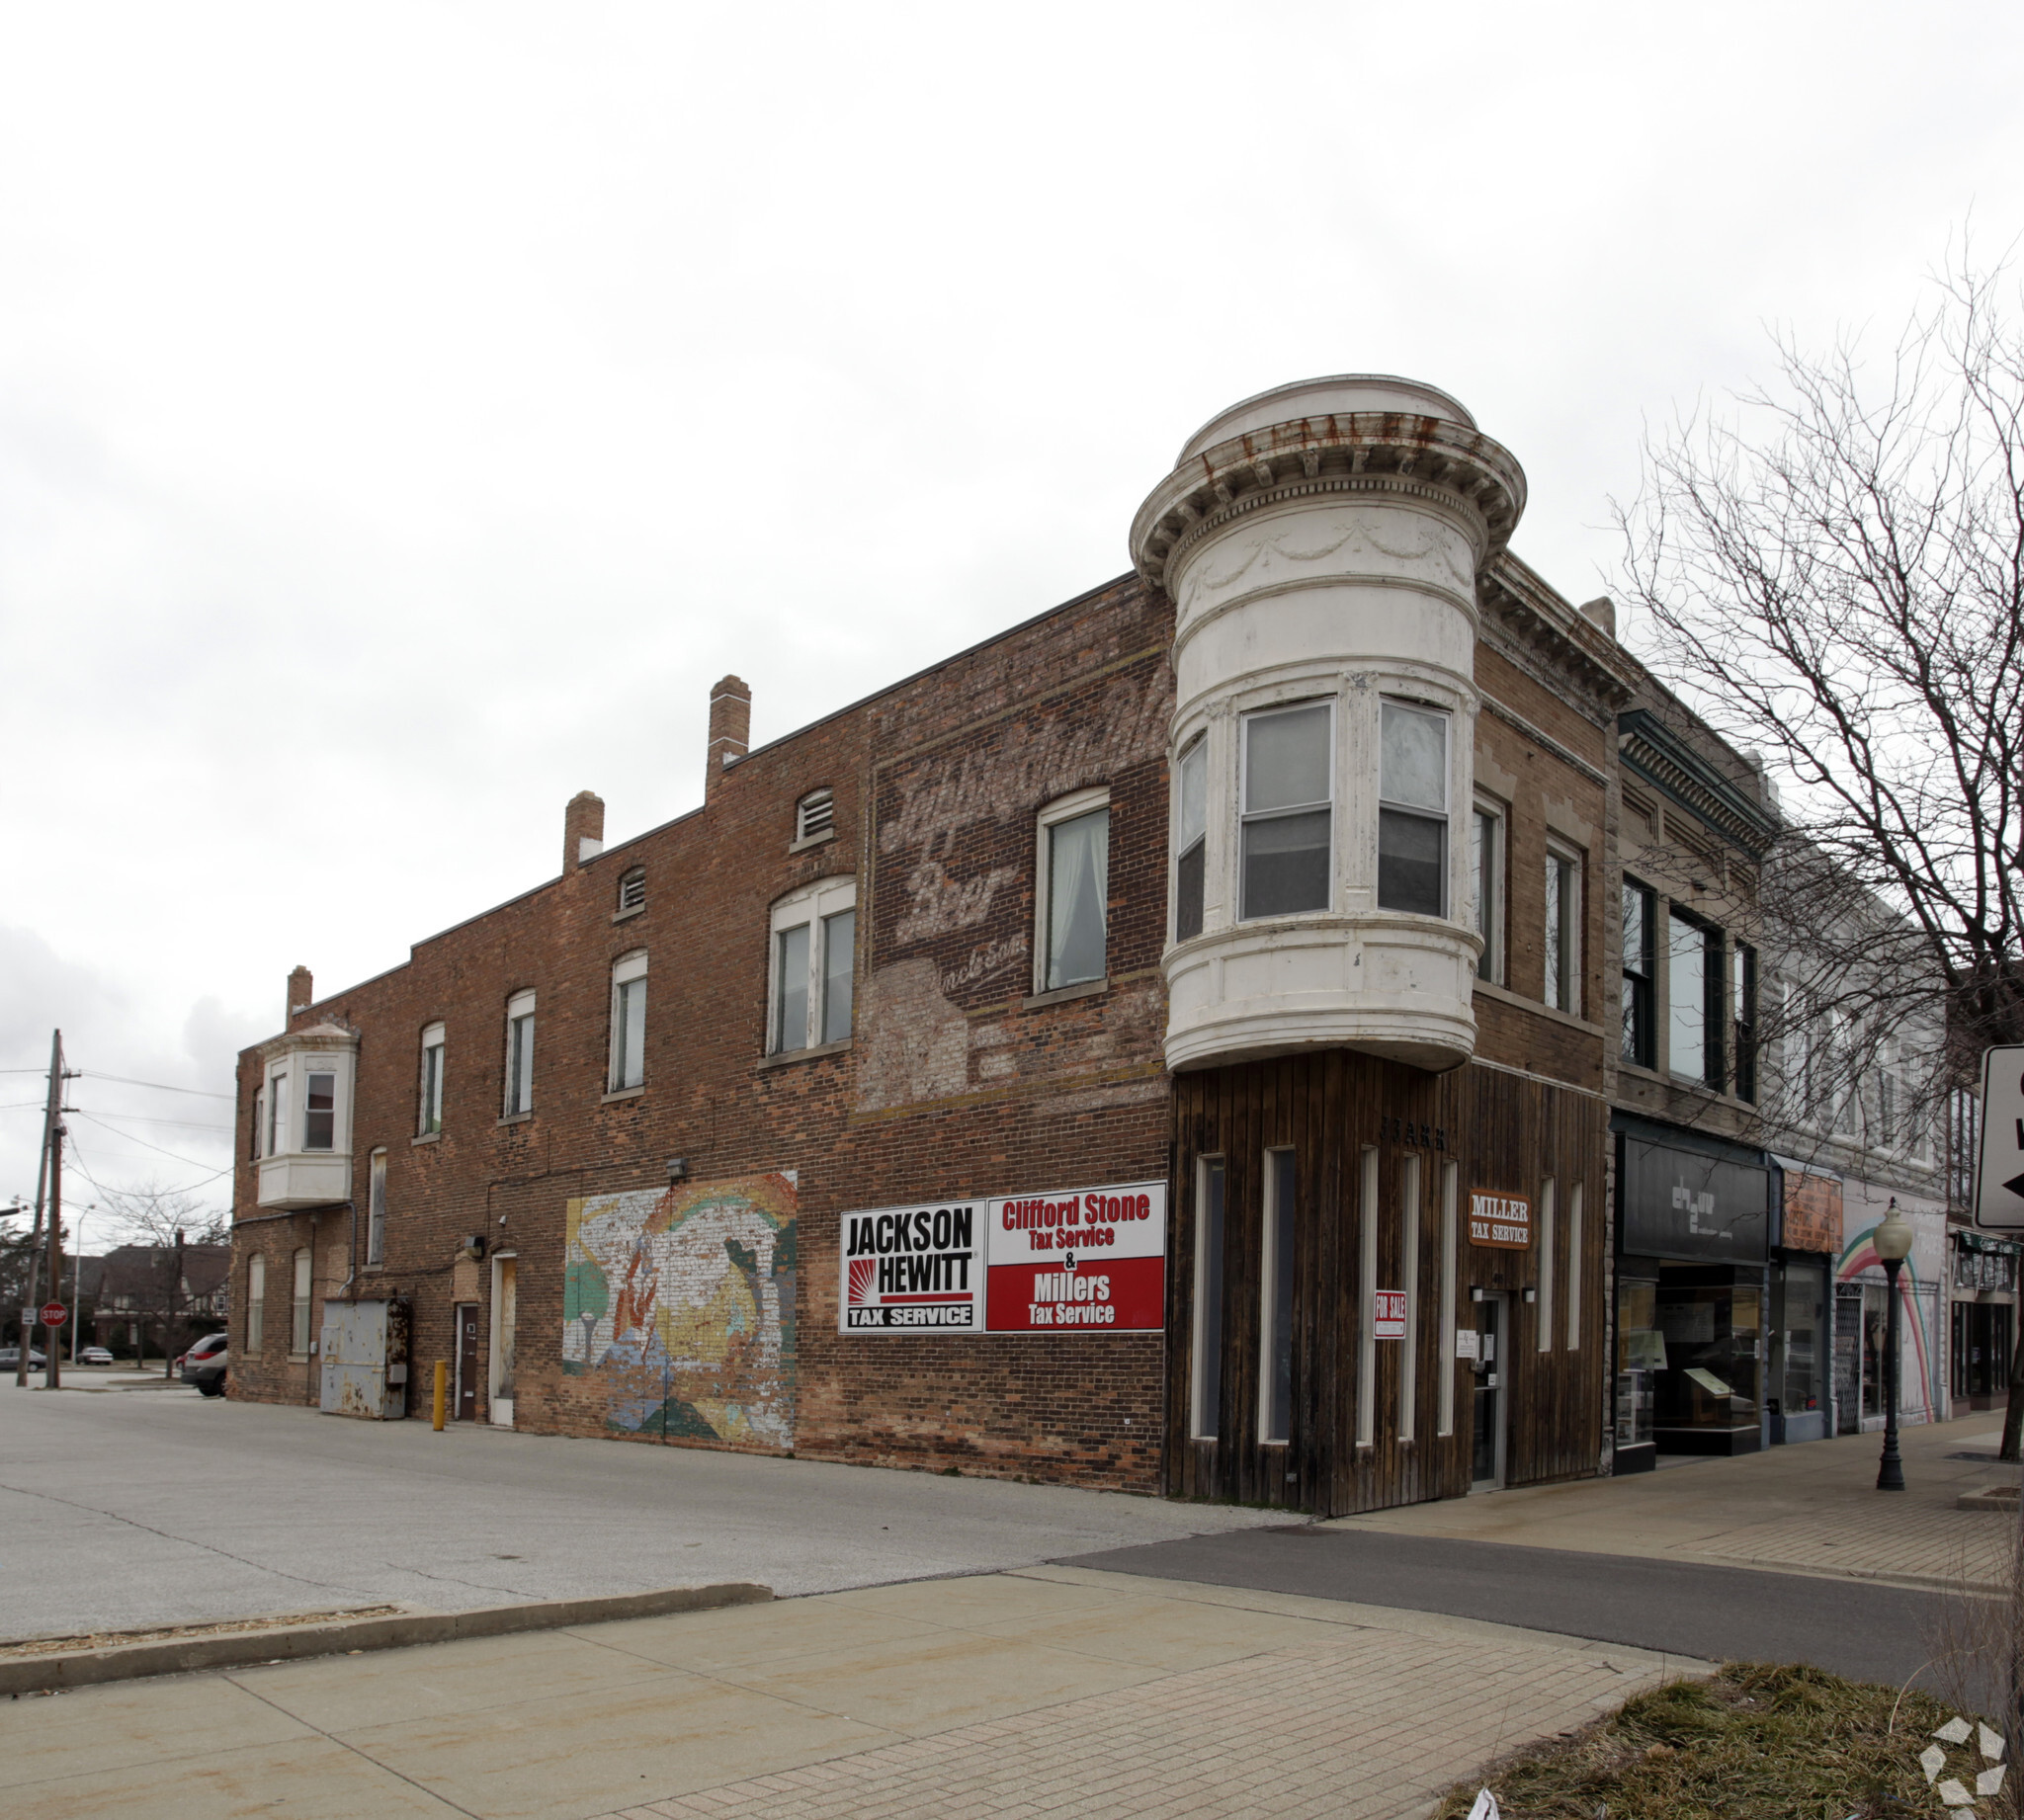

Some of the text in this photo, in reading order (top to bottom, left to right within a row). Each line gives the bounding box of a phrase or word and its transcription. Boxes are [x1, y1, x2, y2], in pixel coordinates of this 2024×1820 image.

[1002, 1193, 1151, 1231] Clifford Stone
[1472, 1194, 1529, 1223] MILLER
[847, 1206, 973, 1257] JACKSON
[1030, 1225, 1115, 1251] Tax Service
[1471, 1221, 1528, 1244] TAX SERVICE
[878, 1252, 972, 1294] HEWITT
[1063, 1251, 1077, 1271] &
[1034, 1272, 1111, 1303] Millers
[42, 1309, 65, 1319] STOP
[849, 1305, 972, 1327] TAX SERVICE
[1028, 1302, 1116, 1325] Tax Service
[1376, 1295, 1405, 1319] FOR SALE
